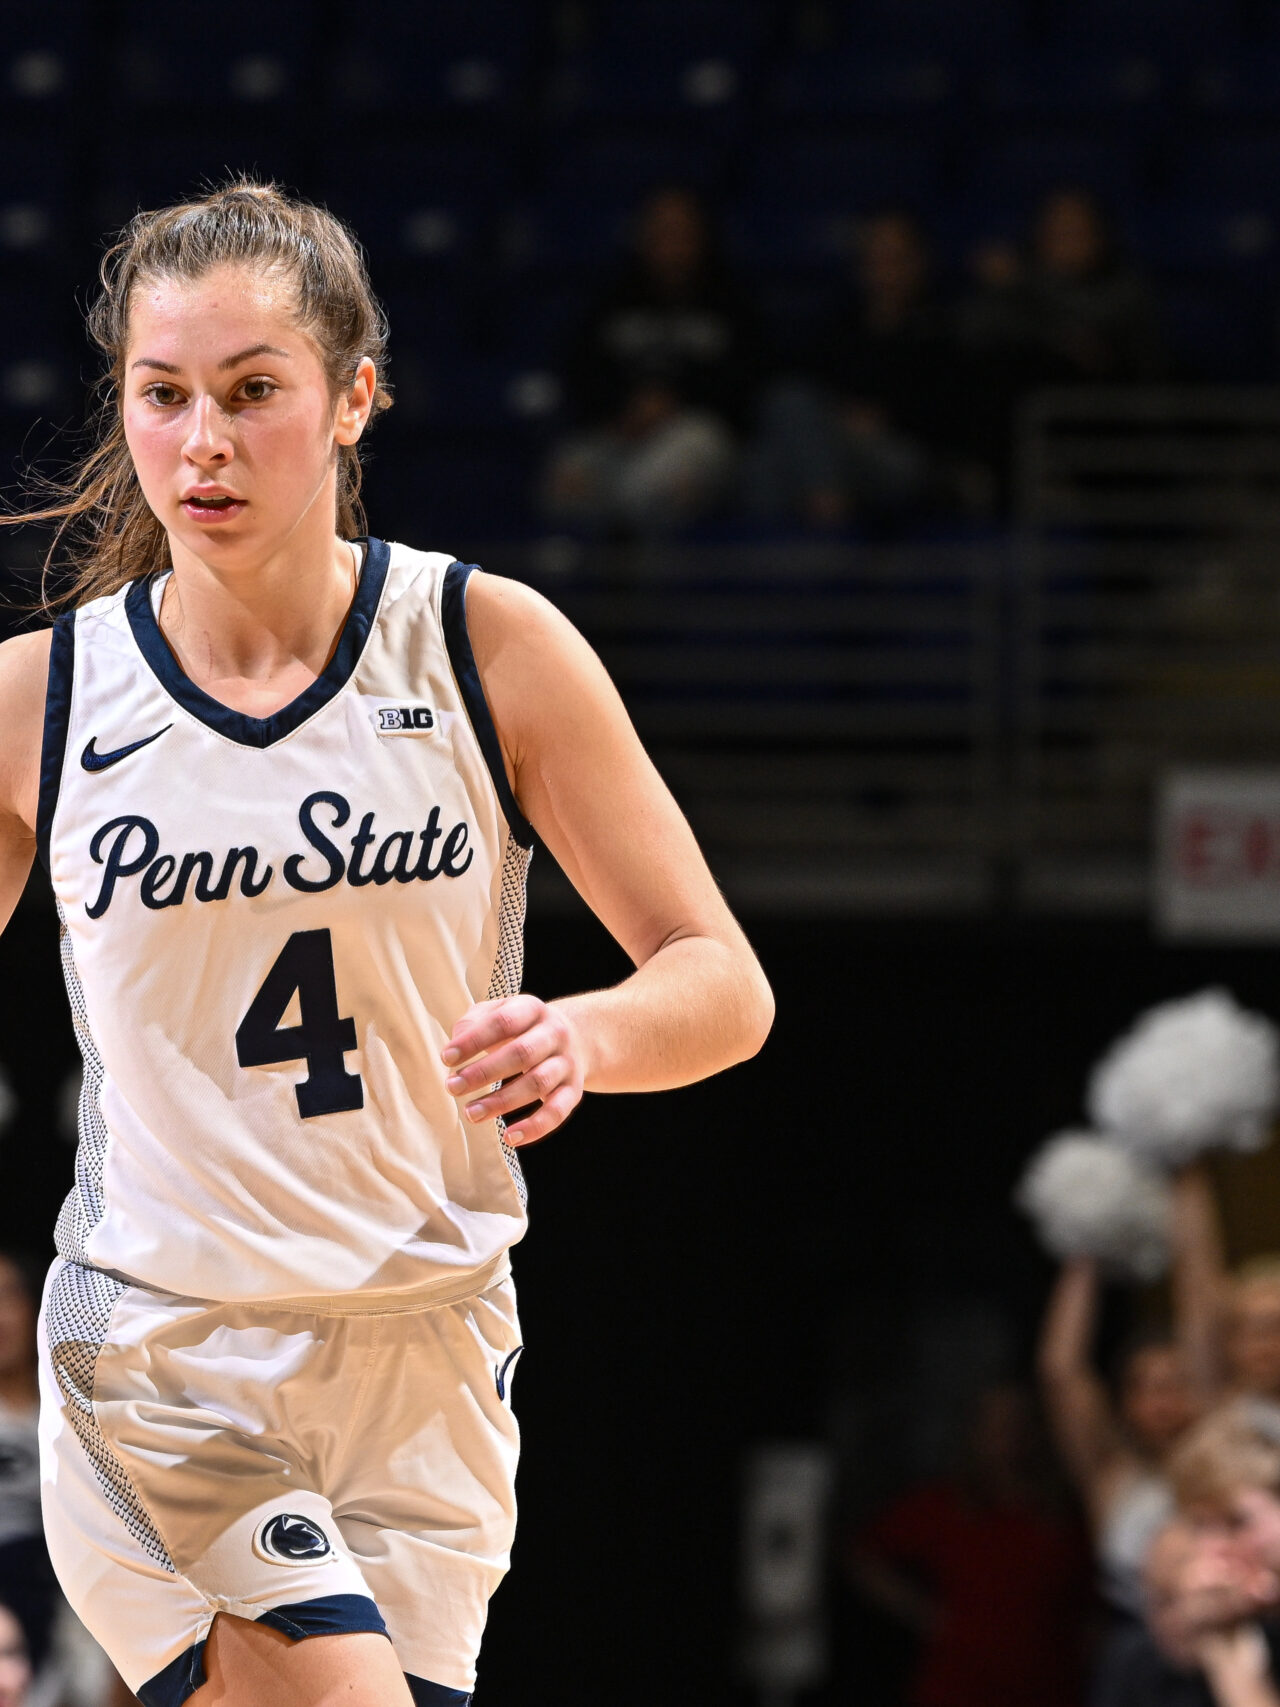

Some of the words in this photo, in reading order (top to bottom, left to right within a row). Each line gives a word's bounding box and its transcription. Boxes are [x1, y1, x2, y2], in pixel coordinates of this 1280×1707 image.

[85, 815, 273, 920] Penn
[282, 790, 474, 893] State
[235, 927, 364, 1120] 4
